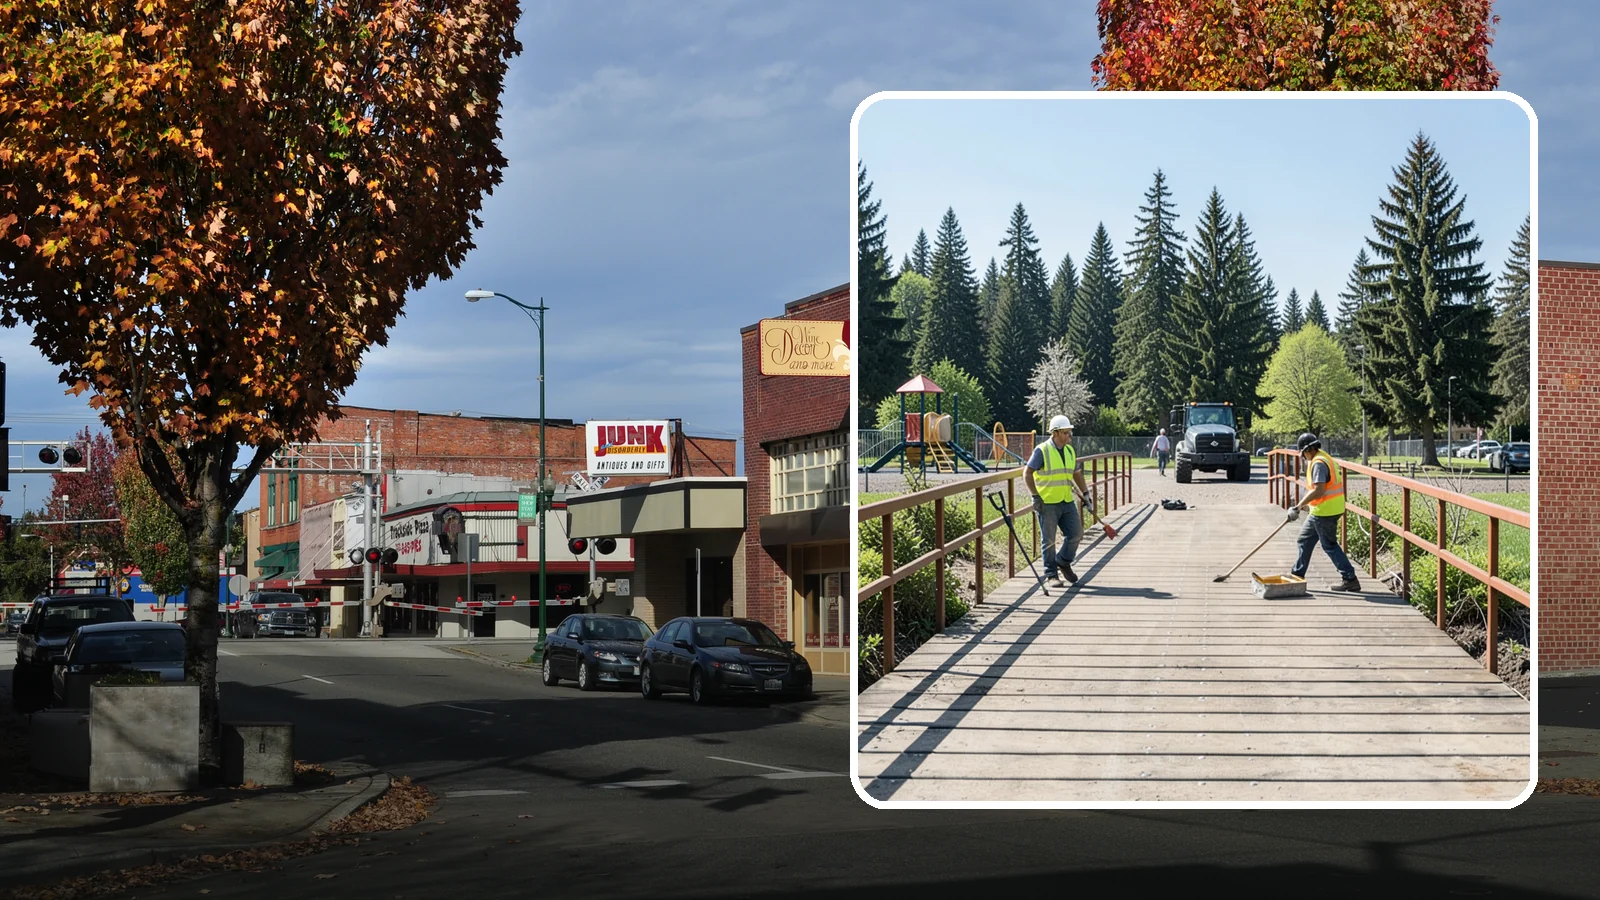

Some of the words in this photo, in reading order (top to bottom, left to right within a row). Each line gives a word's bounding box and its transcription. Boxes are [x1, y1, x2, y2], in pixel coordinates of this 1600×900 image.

[595, 425, 665, 457] JUNK
[608, 446, 646, 454] DISORDERLY
[597, 461, 628, 470] ANTIQUES
[631, 461, 644, 470] AND
[647, 460, 665, 469] GIFTS
[414, 519, 429, 535] Pizza
